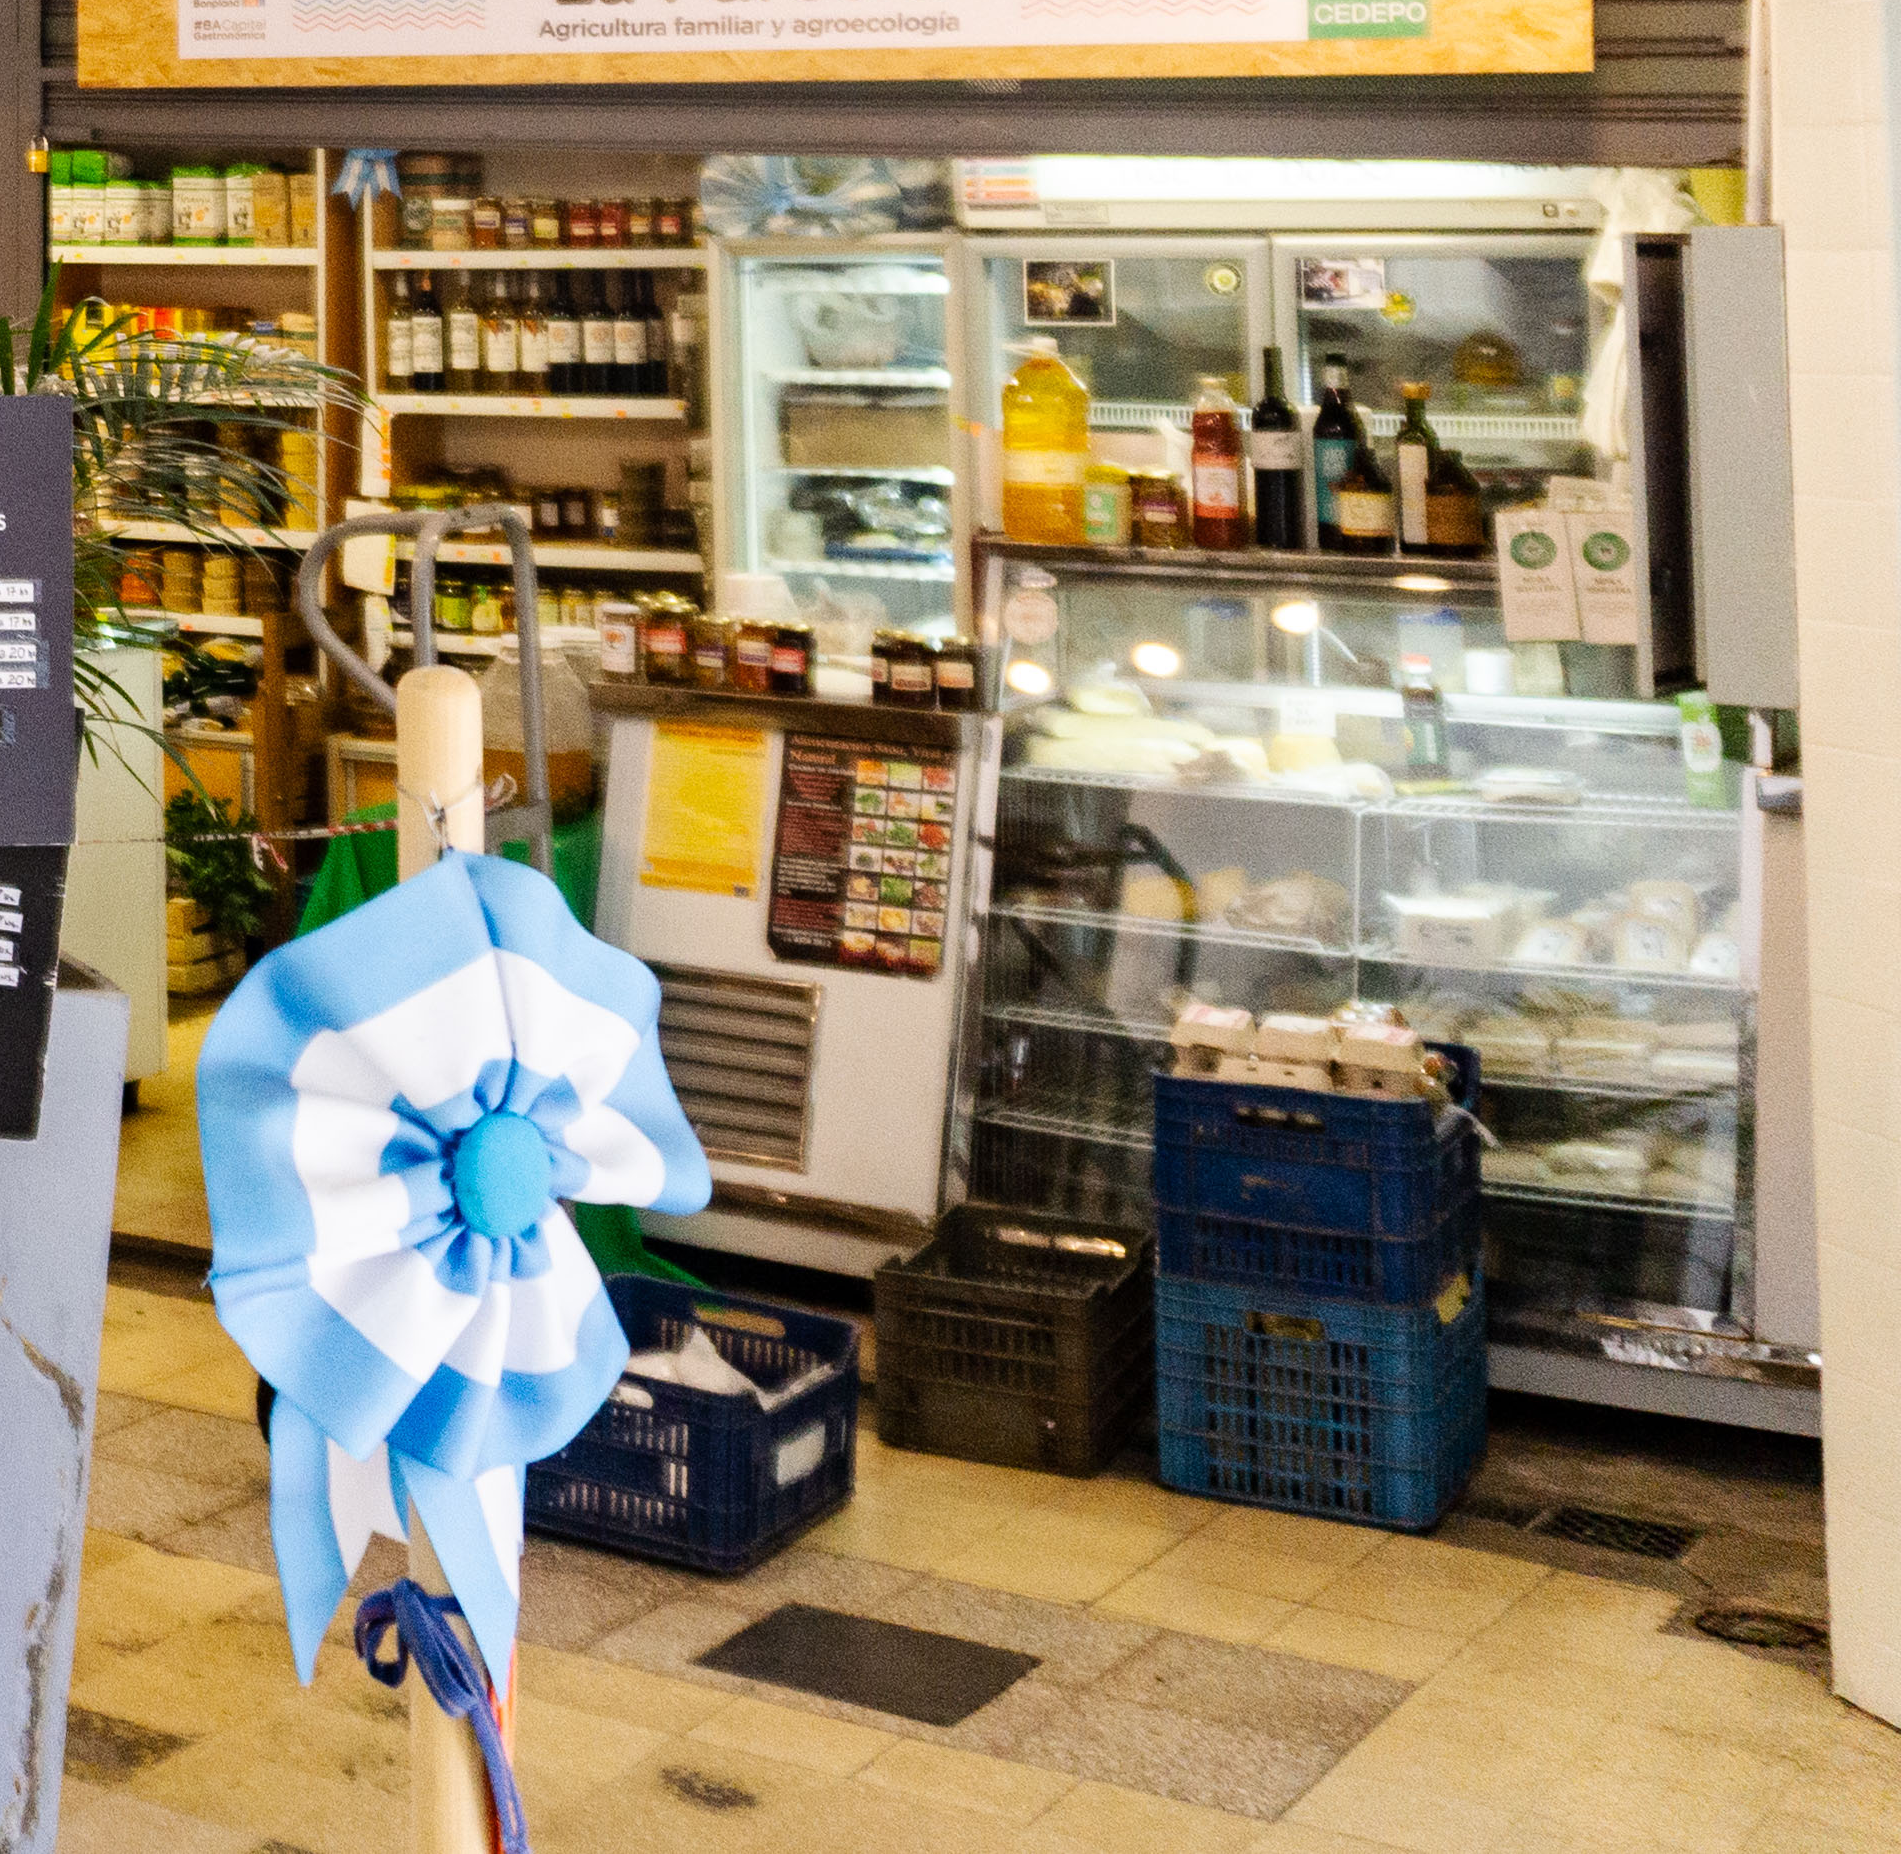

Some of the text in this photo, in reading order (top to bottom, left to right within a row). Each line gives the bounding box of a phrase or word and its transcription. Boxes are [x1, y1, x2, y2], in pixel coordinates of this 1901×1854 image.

[1313, 0, 1427, 26] CEDEPO
[539, 11, 960, 41] Agricultura familiar y agroecología
[8, 646, 26, 659] 20
[7, 673, 25, 686] 20
